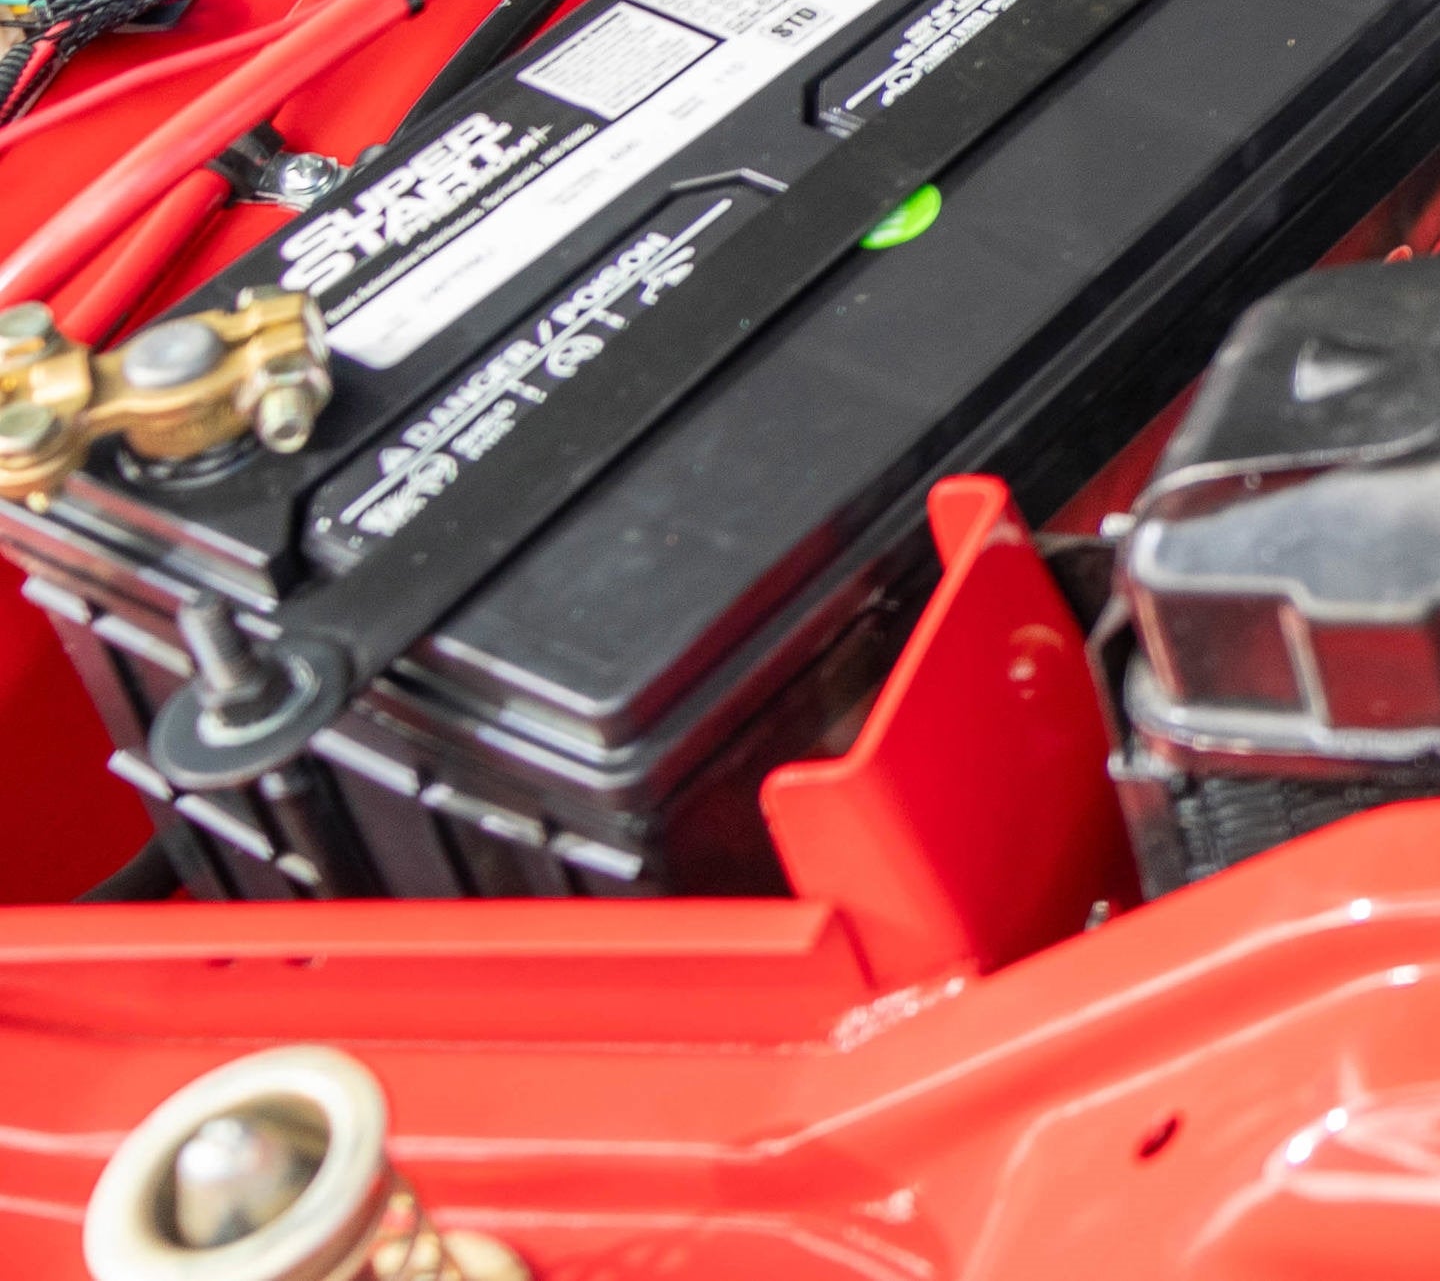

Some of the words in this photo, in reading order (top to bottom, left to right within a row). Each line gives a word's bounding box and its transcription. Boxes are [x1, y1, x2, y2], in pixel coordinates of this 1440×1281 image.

[768, 8, 819, 38] STD
[279, 111, 500, 269] SUPER
[282, 124, 511, 297] START
[401, 334, 542, 451] DANGER
[550, 229, 672, 327] POISON
